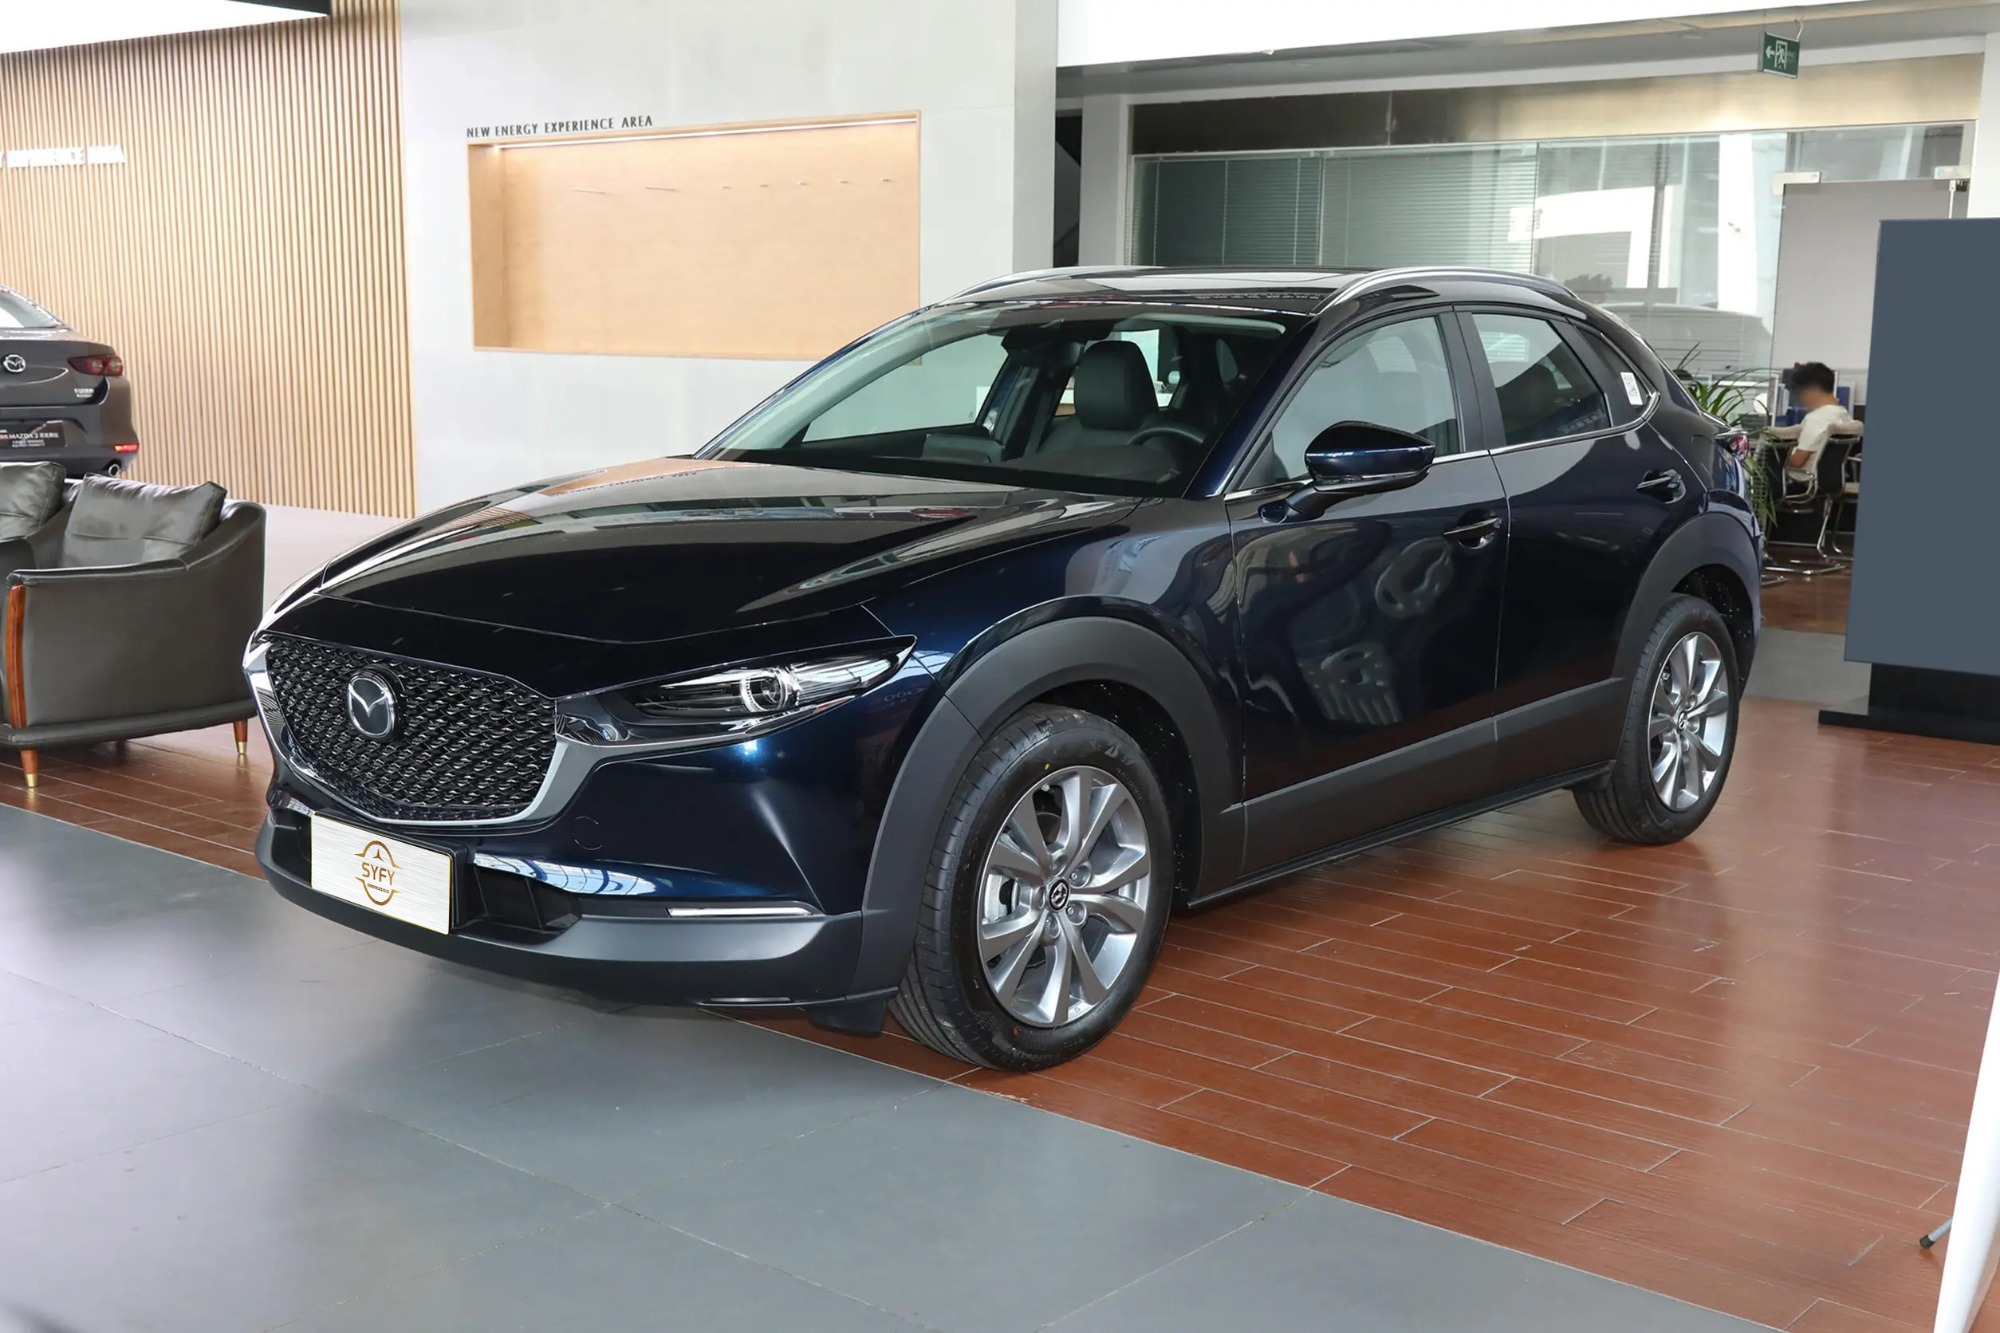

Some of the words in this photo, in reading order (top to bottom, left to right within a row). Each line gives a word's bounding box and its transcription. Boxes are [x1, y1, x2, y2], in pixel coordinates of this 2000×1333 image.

[466, 126, 490, 138] NEW
[495, 123, 538, 137] ENERGY
[544, 117, 614, 134] EXPERIENCE
[621, 115, 653, 128] AREA
[361, 861, 395, 886] SYFY
